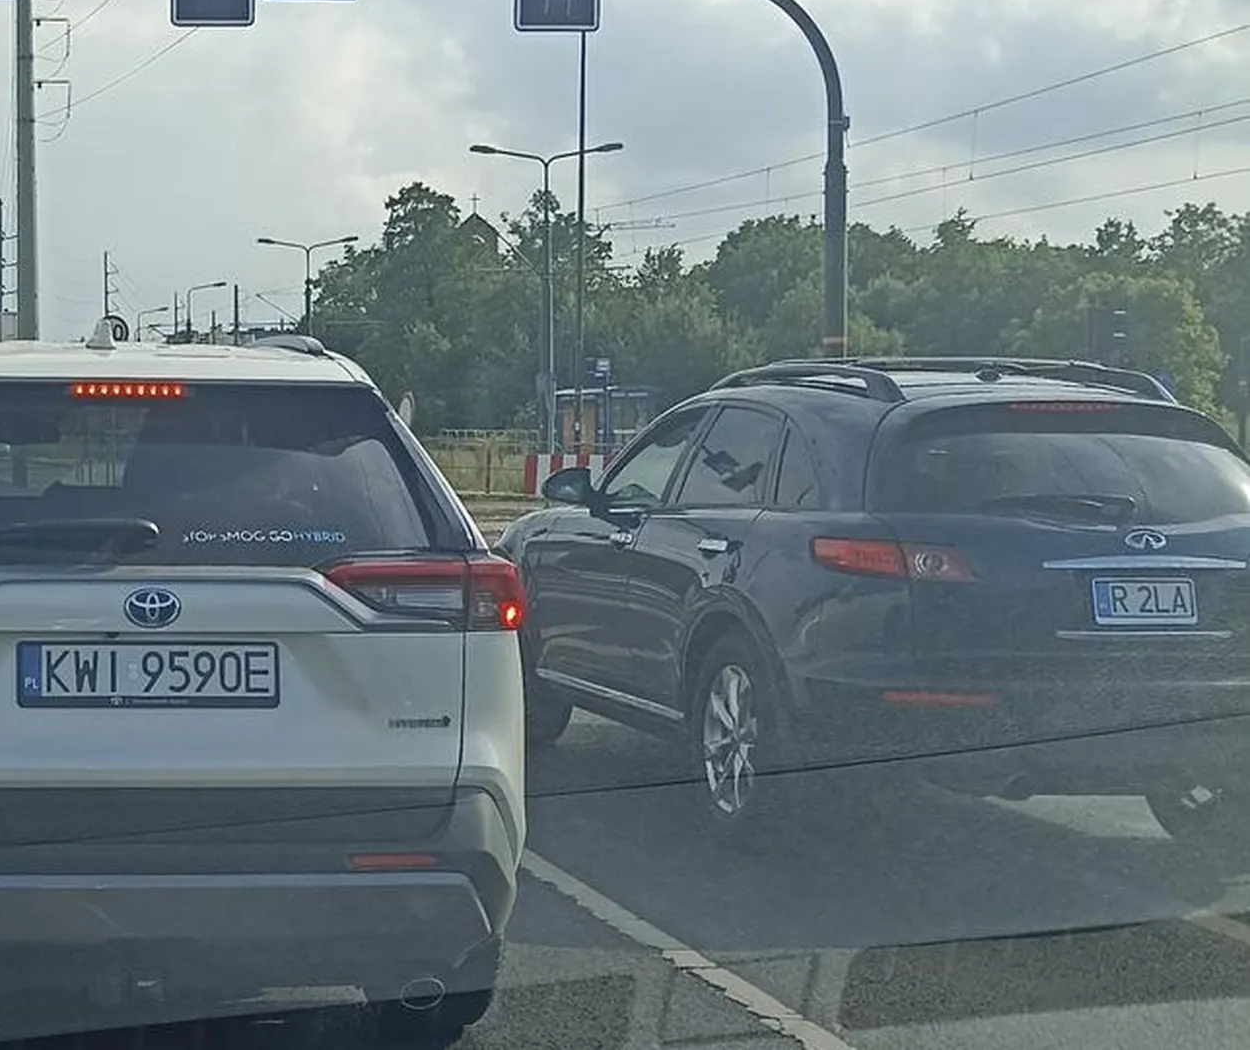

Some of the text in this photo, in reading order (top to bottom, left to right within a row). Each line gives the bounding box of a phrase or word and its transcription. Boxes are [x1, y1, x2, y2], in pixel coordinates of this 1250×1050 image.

[1111, 585, 1129, 613] R
[1136, 585, 1189, 613] 2LA
[46, 650, 269, 693] KWI 9590E
